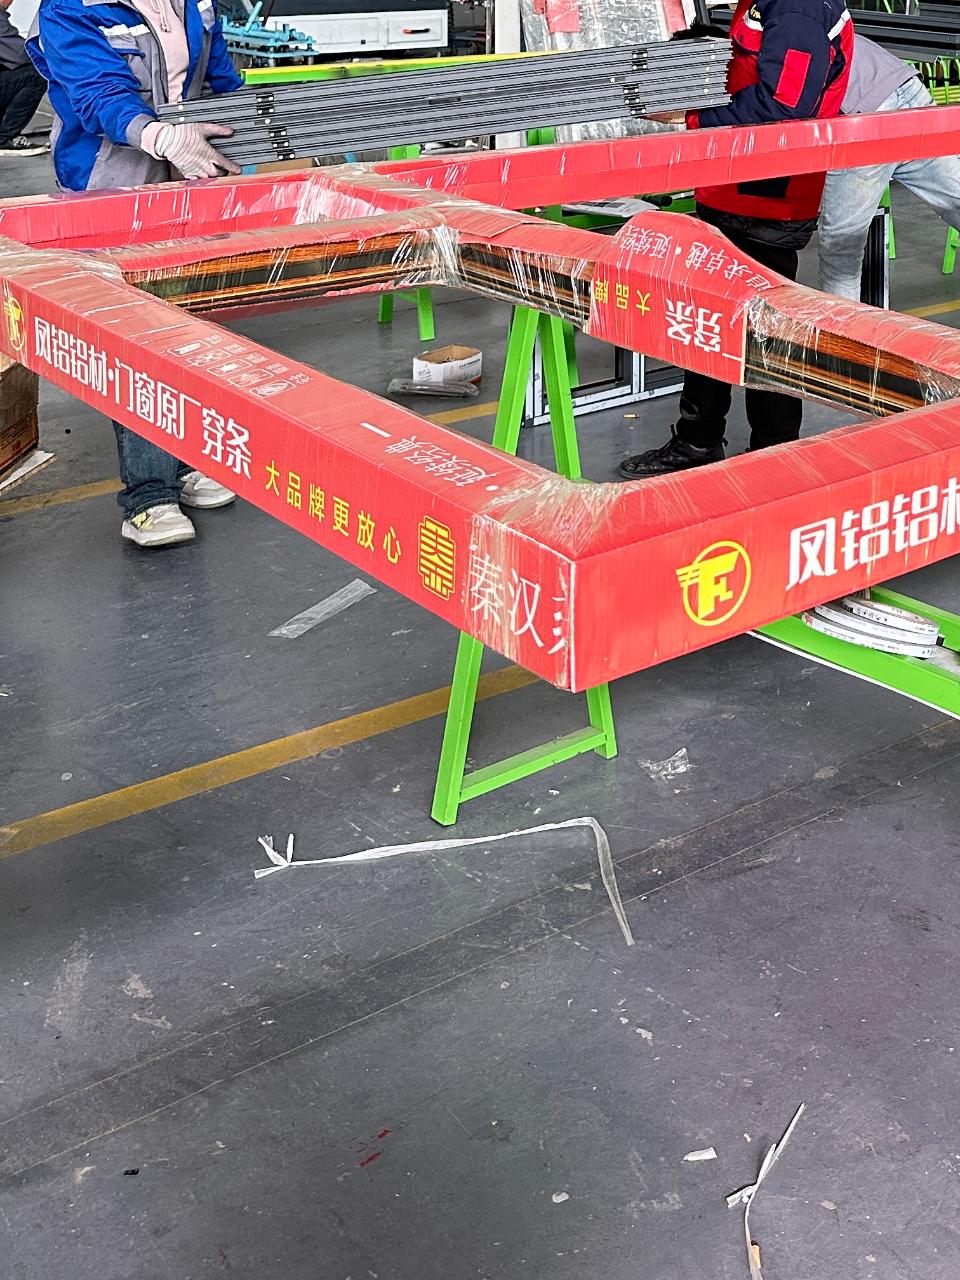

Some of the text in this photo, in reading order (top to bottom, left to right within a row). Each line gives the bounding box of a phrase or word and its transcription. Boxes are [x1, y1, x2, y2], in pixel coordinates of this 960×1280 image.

[34, 316, 254, 480] 凤铝铝材·门窗原厂穿条
[264, 458, 403, 566] 大品牌更放心
